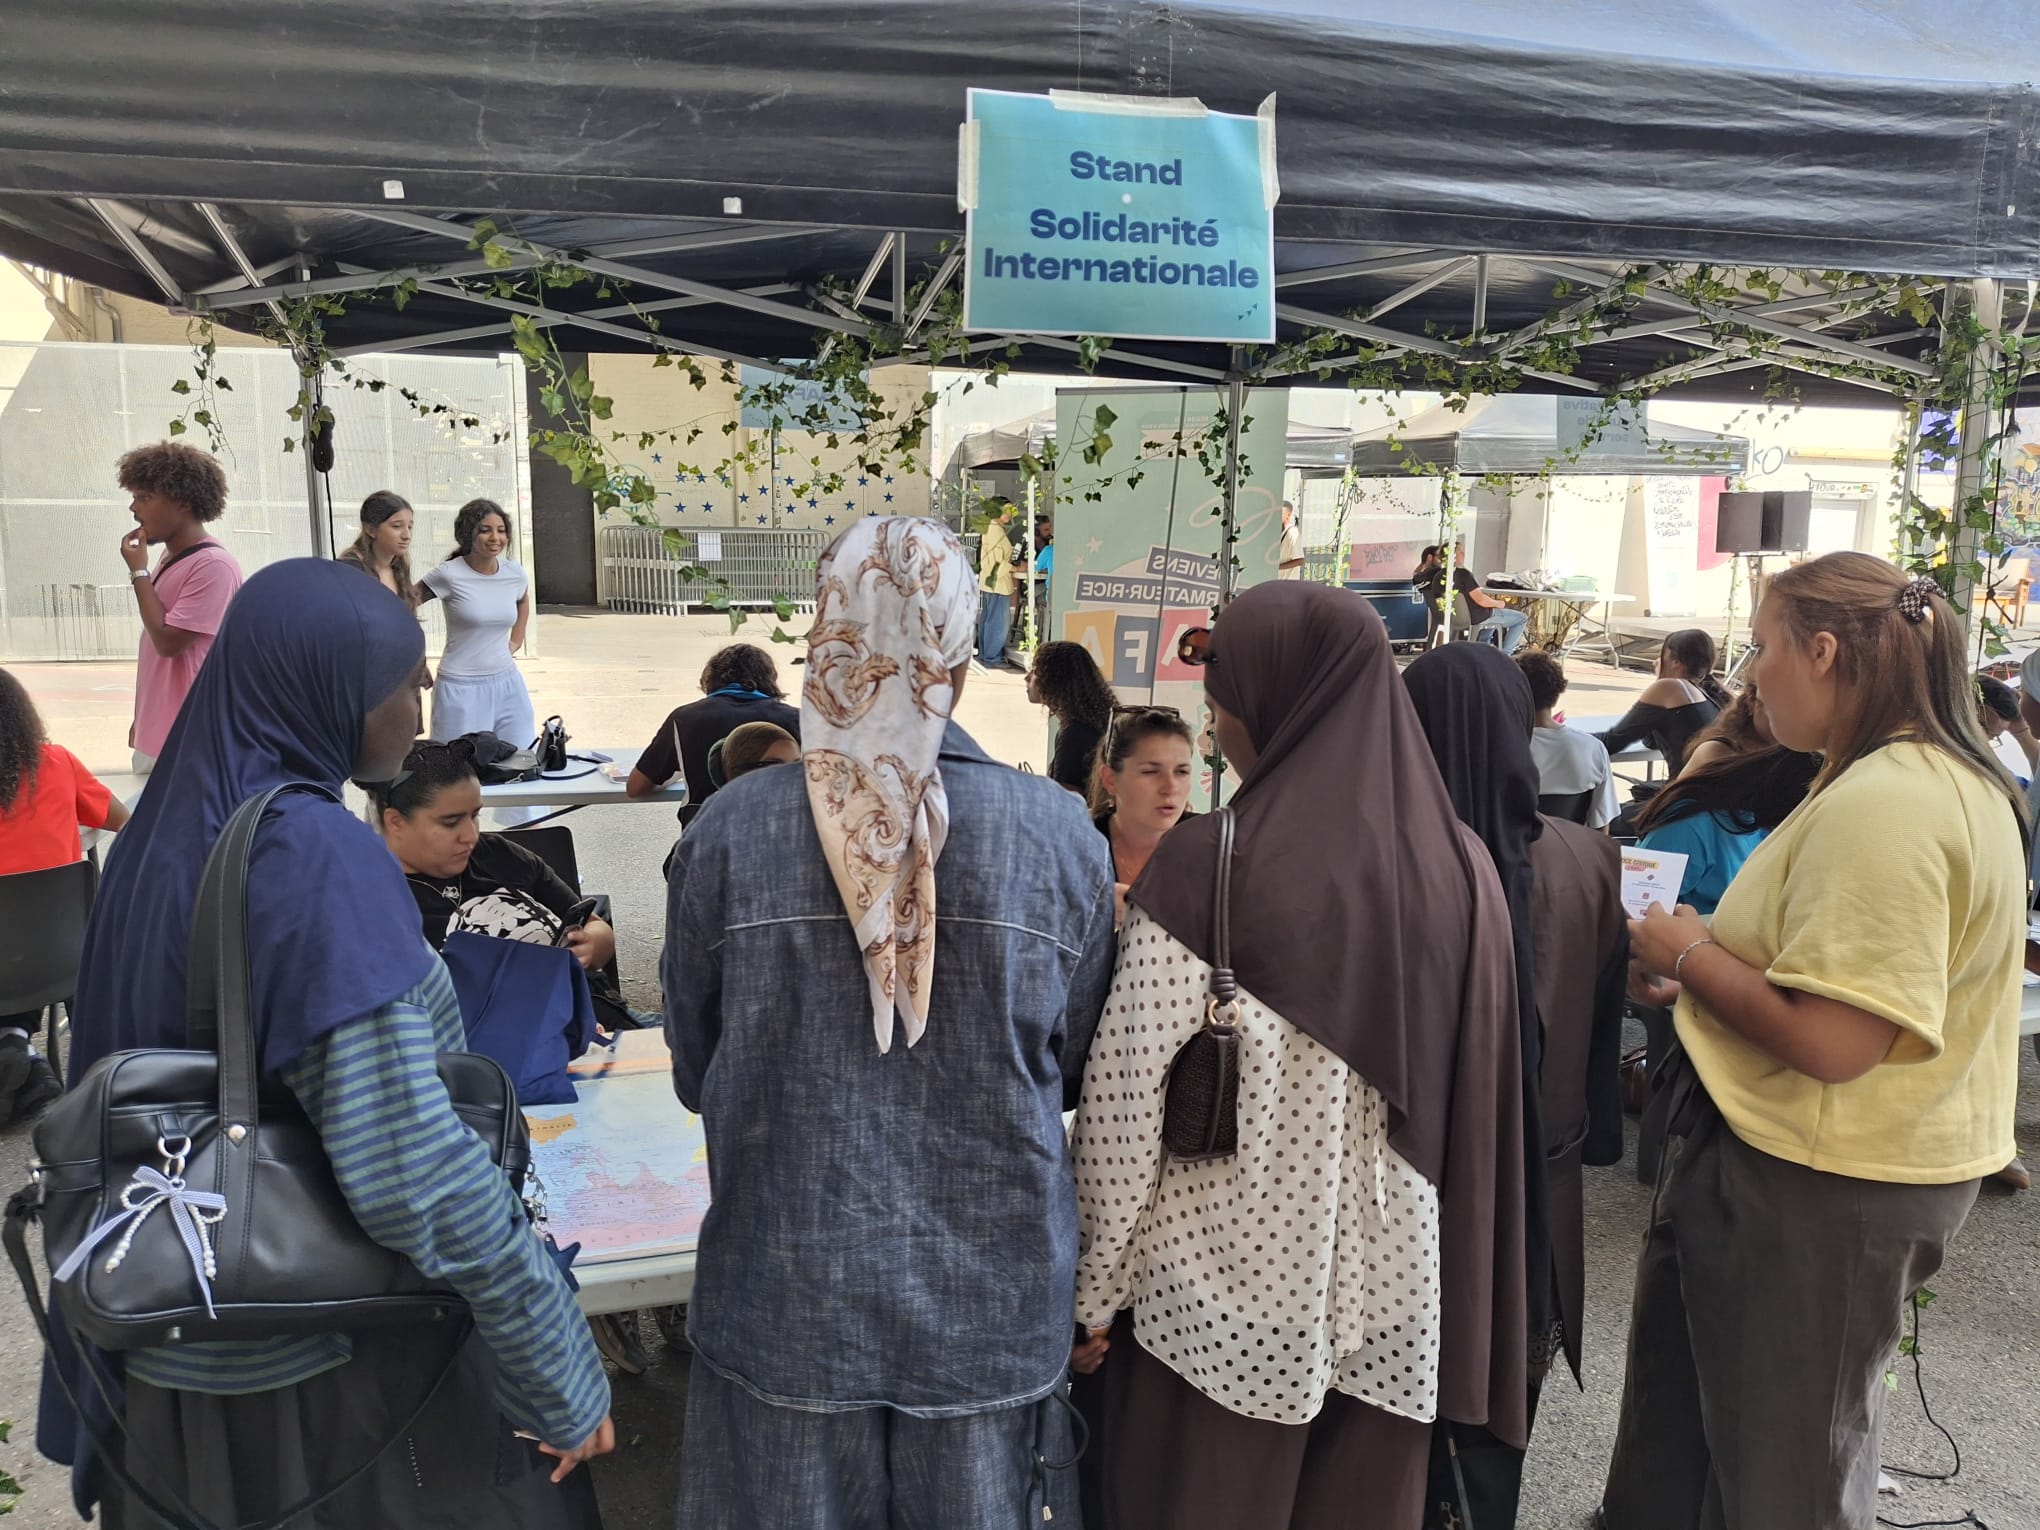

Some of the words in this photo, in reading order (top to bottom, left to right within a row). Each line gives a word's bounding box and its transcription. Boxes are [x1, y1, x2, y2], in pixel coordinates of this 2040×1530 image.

[1069, 150, 1183, 187] Stand
[1029, 207, 1220, 249] Solidarité
[983, 247, 1260, 289] Internationale
